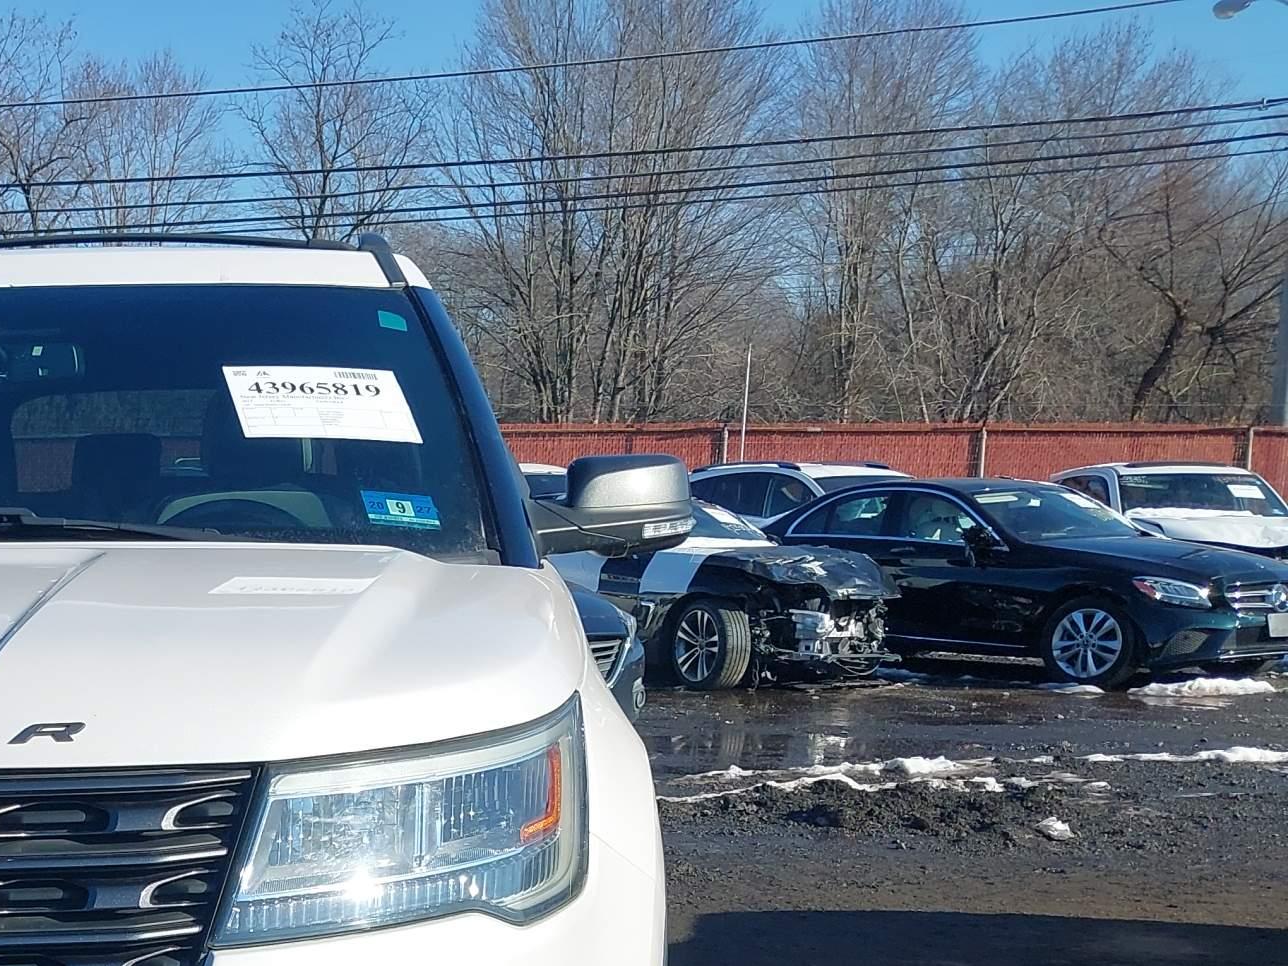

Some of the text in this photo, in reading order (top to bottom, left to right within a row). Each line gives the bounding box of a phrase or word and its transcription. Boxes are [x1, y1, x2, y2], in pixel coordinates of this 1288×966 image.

[248, 381, 381, 397] 43965819
[368, 501, 432, 515] 20 9 27
